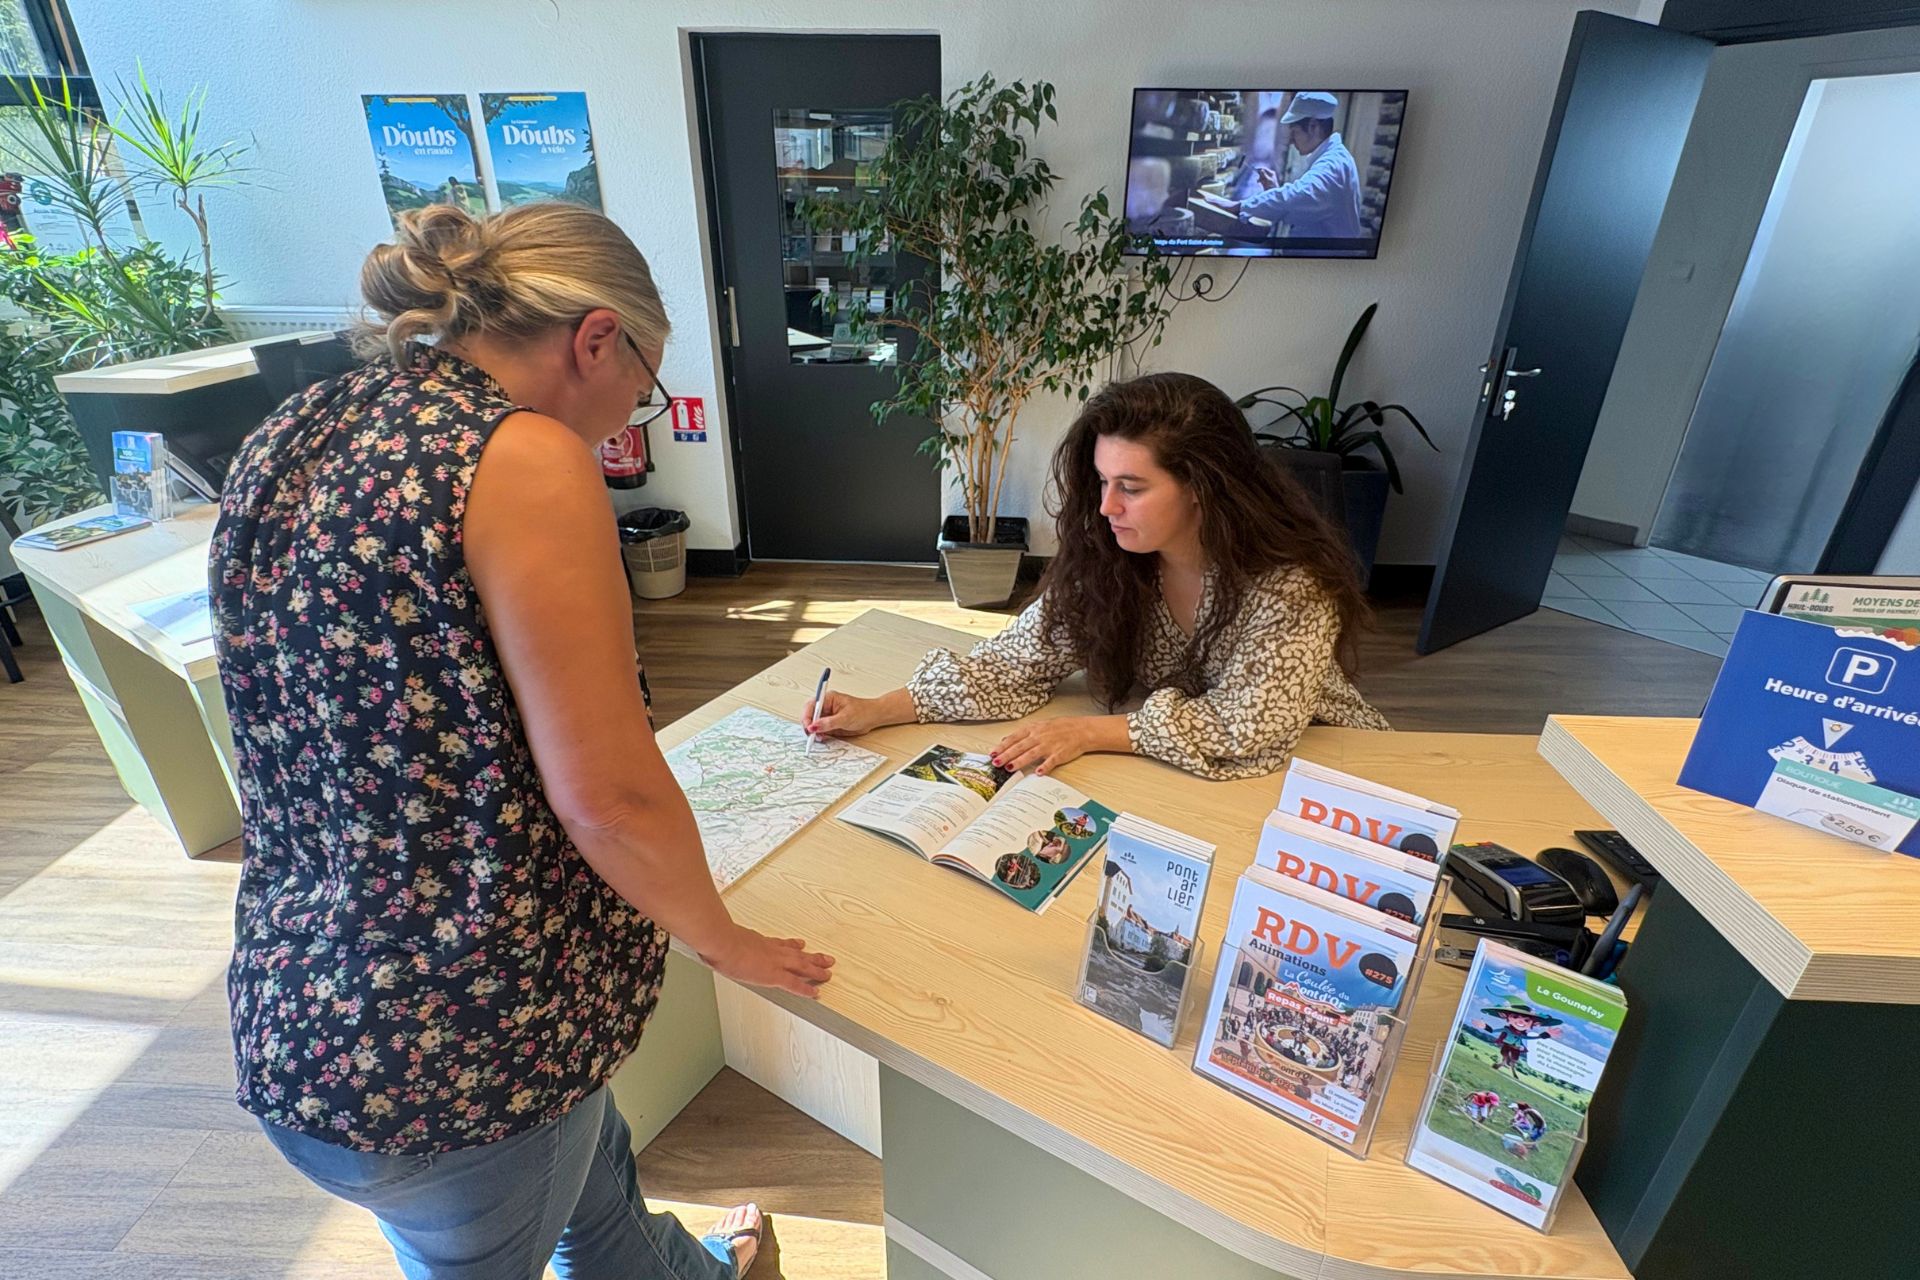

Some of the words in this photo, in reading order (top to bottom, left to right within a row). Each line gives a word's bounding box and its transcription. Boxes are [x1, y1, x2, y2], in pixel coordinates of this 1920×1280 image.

[382, 125, 457, 147] Doubs
[502, 125, 577, 146] Doubs
[1852, 597, 1904, 607] MOYENS
[1905, 598, 1920, 608] DE
[1842, 654, 1879, 684] P
[1764, 678, 1829, 704] Heure
[1833, 695, 1920, 727] d'arrivé
[1829, 761, 1840, 774] 4
[1776, 776, 1807, 791] Disque
[1822, 793, 1891, 818] stationnement
[1166, 860, 1199, 881] pont
[1180, 879, 1198, 894] ar
[1251, 906, 1362, 970] RDV
[1249, 938, 1327, 976] Animations
[1284, 969, 1295, 979] La
[1296, 971, 1337, 995] Coulée
[1338, 991, 1350, 1001] du
[1365, 968, 1394, 985] #275
[1267, 991, 1302, 1010] Repas
[1303, 1006, 1335, 1025] Géant
[1536, 985, 1550, 996] Le
[1552, 991, 1605, 1019] Gounefay
